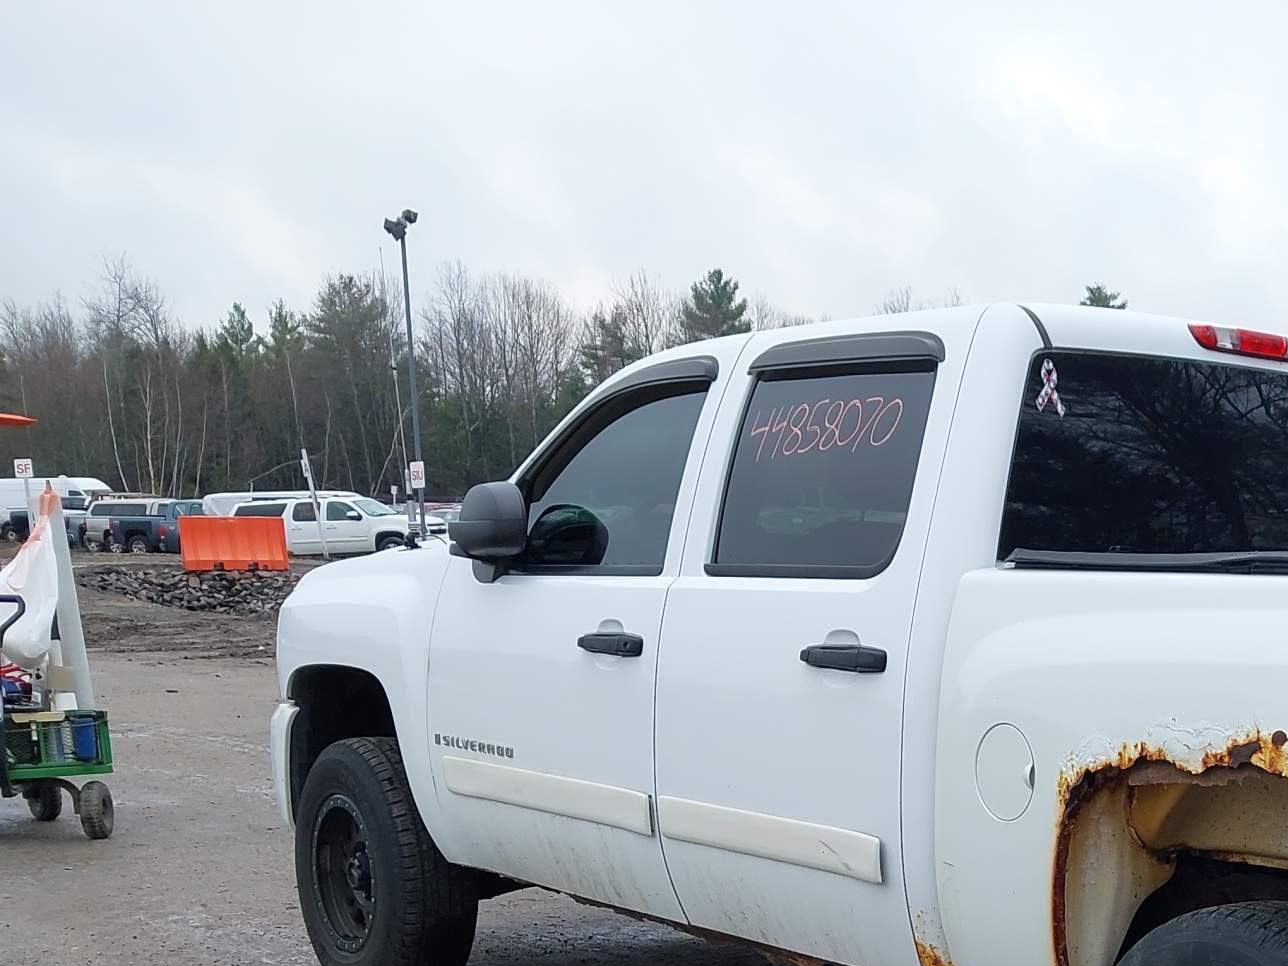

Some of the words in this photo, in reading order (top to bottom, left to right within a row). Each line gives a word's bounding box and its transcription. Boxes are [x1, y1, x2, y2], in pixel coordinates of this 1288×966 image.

[751, 397, 903, 463] 44858070
[16, 463, 31, 474] SF
[442, 735, 514, 759] SILVERADO
